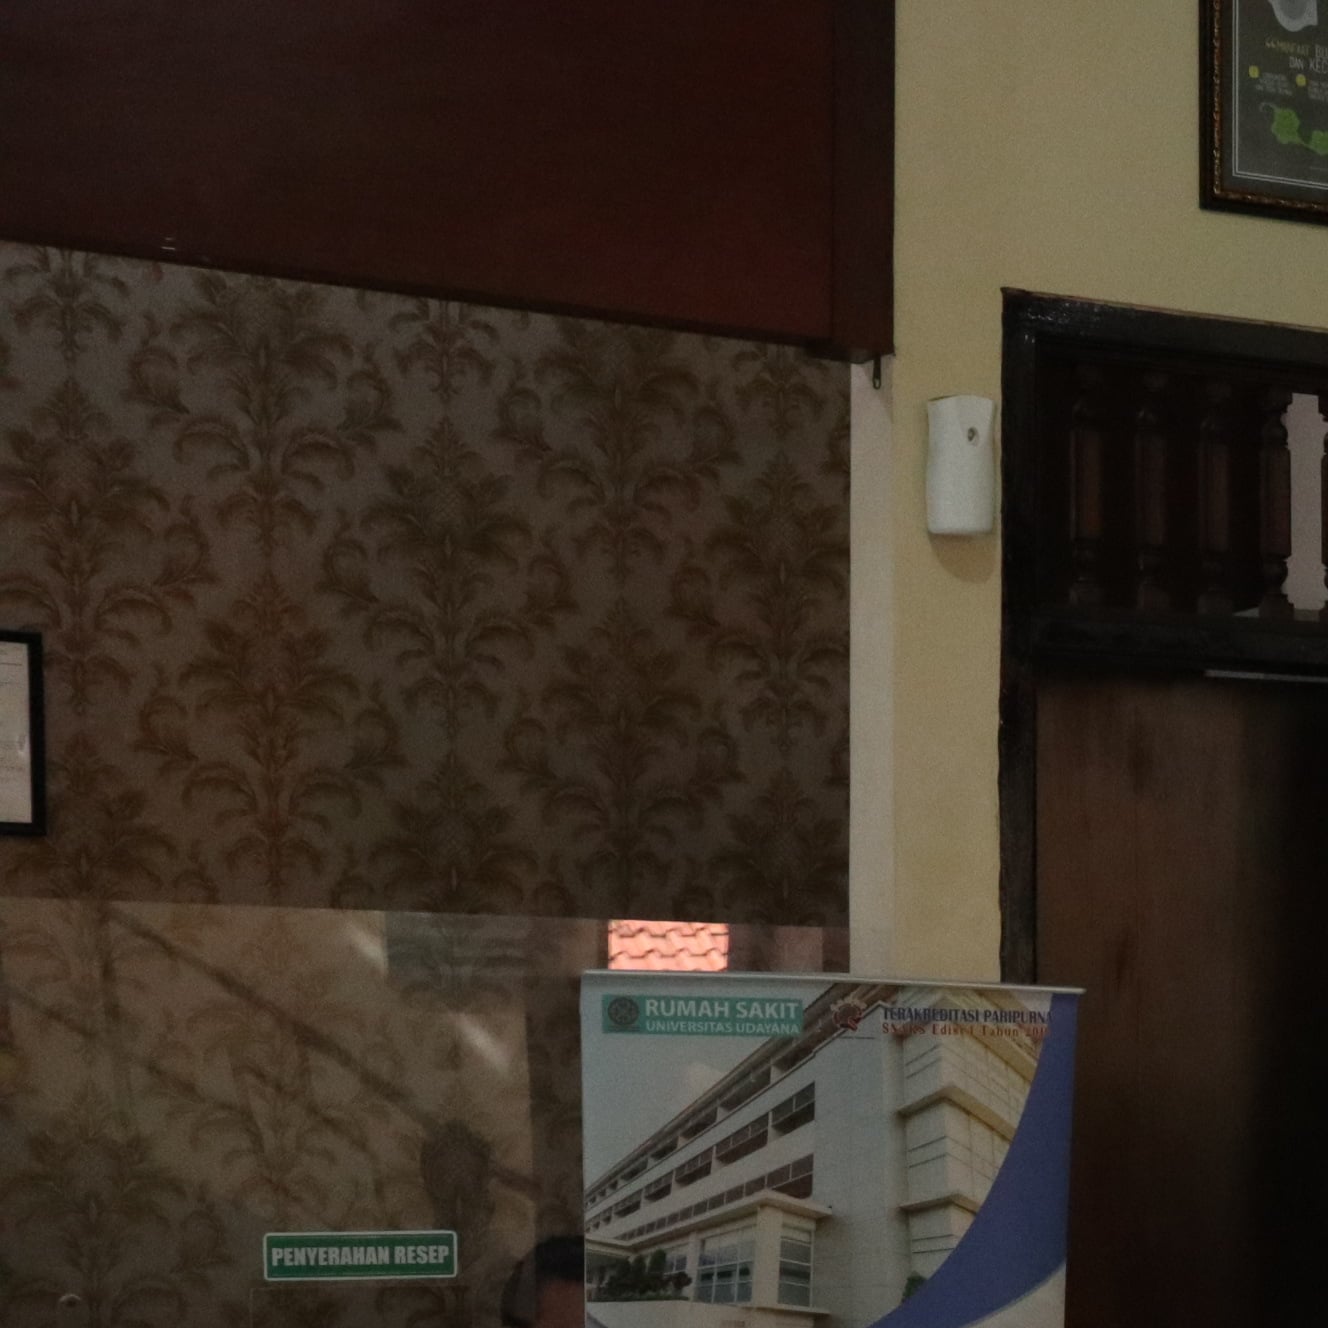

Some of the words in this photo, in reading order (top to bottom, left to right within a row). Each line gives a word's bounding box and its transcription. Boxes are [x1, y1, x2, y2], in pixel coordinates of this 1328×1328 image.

[645, 999, 729, 1018] RUMAH
[735, 1001, 800, 1019] SAKIT
[646, 1022, 733, 1033] UNIVERSITAS
[737, 1023, 800, 1035] UDAYANA
[272, 1246, 390, 1266] PENYERAHAN
[394, 1245, 449, 1264] RESEP
